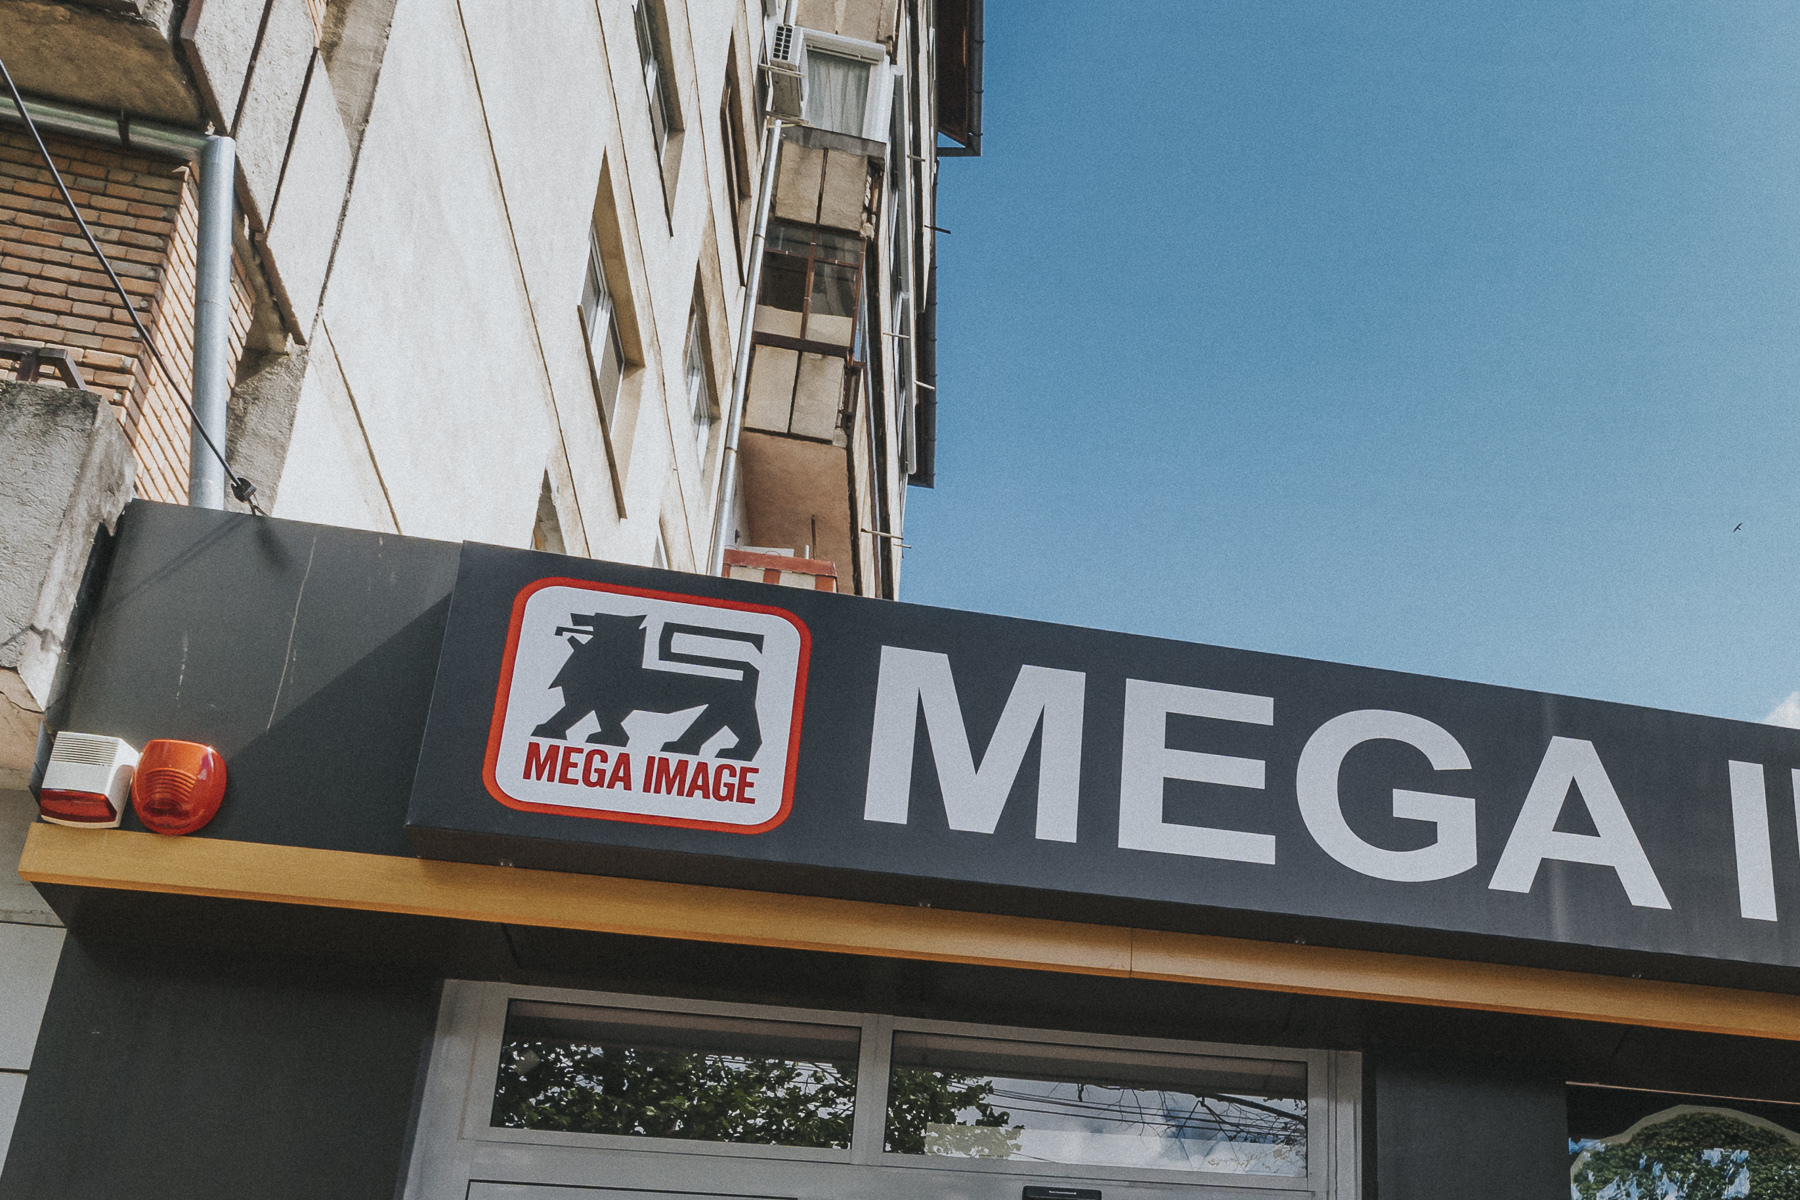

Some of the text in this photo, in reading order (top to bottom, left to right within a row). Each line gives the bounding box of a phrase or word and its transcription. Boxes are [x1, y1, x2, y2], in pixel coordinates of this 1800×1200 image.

[522, 741, 760, 805] MEGA IMAGE
[863, 645, 1673, 911] MEGA
